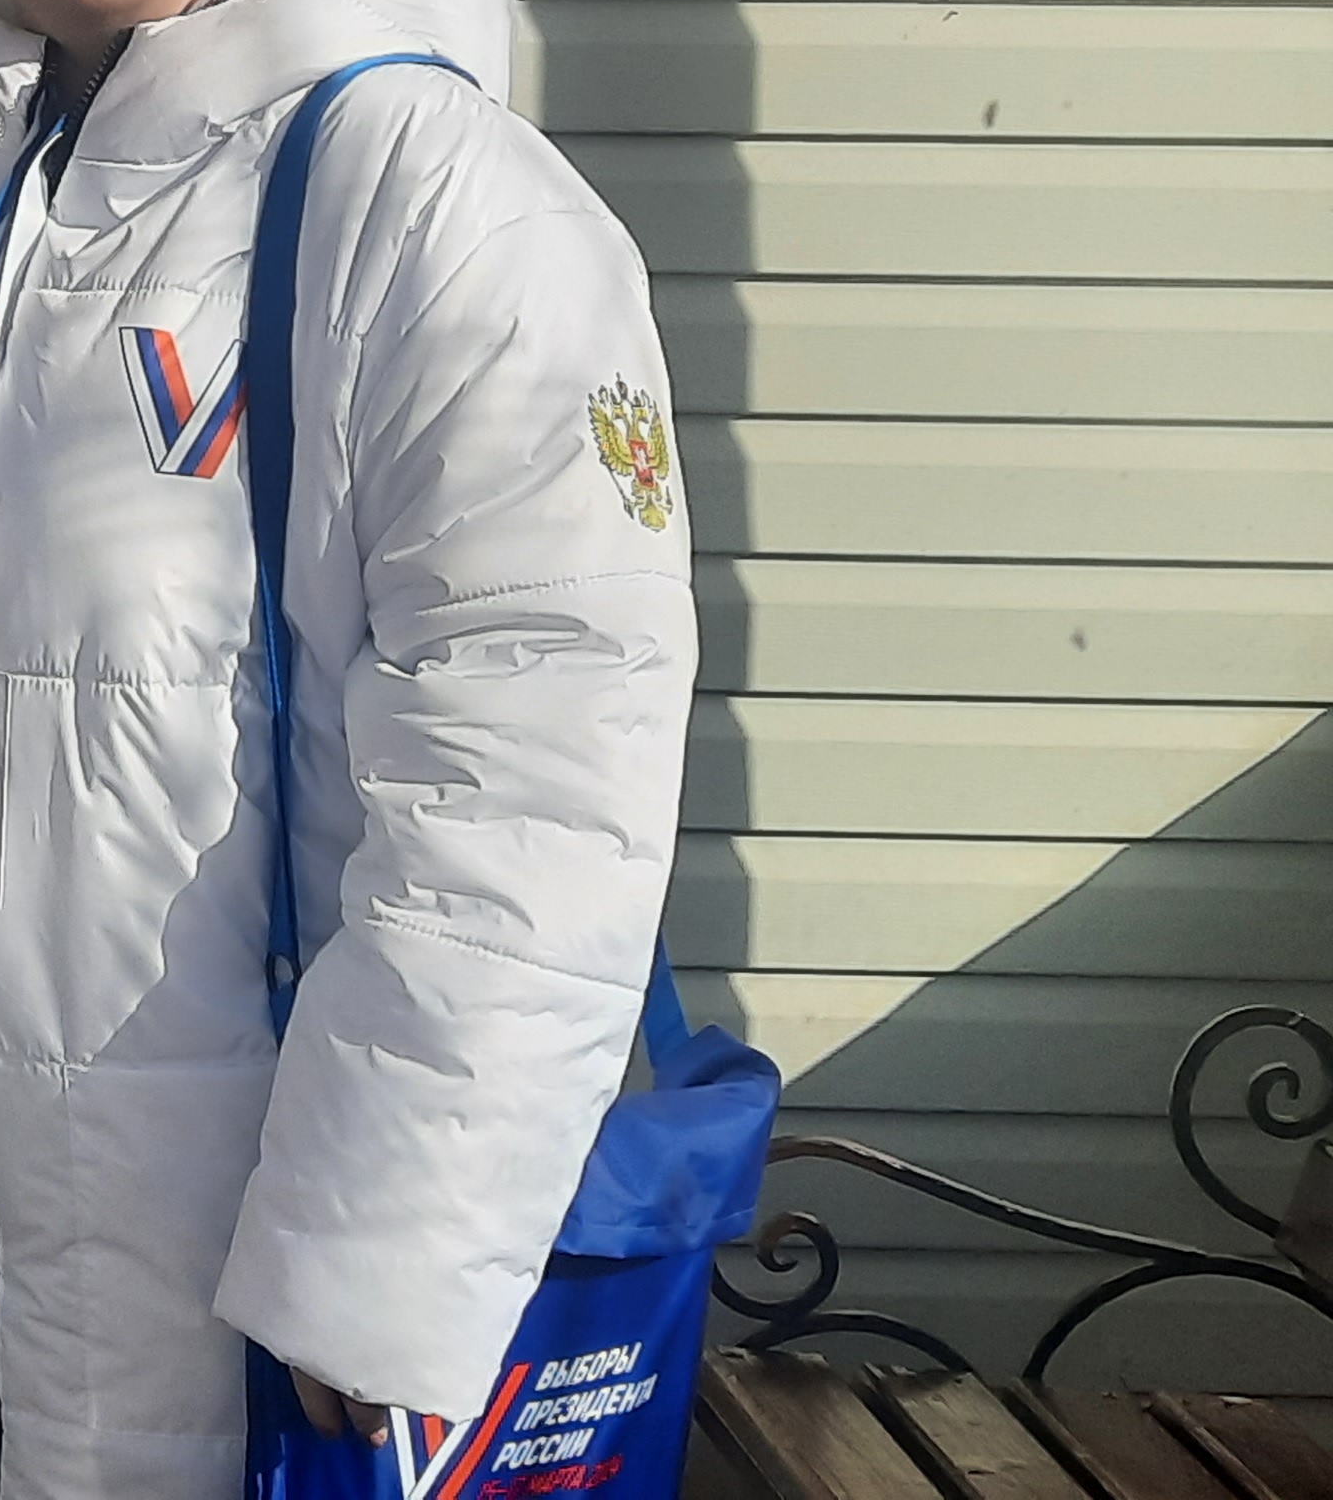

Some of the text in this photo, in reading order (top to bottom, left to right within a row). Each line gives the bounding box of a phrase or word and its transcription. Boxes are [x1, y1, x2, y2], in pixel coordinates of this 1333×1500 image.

[535, 1341, 642, 1392] ВЫБОРЫ
[513, 1373, 658, 1432] ПРЕЗИДЕНТА
[491, 1427, 595, 1472] РОССИИ
